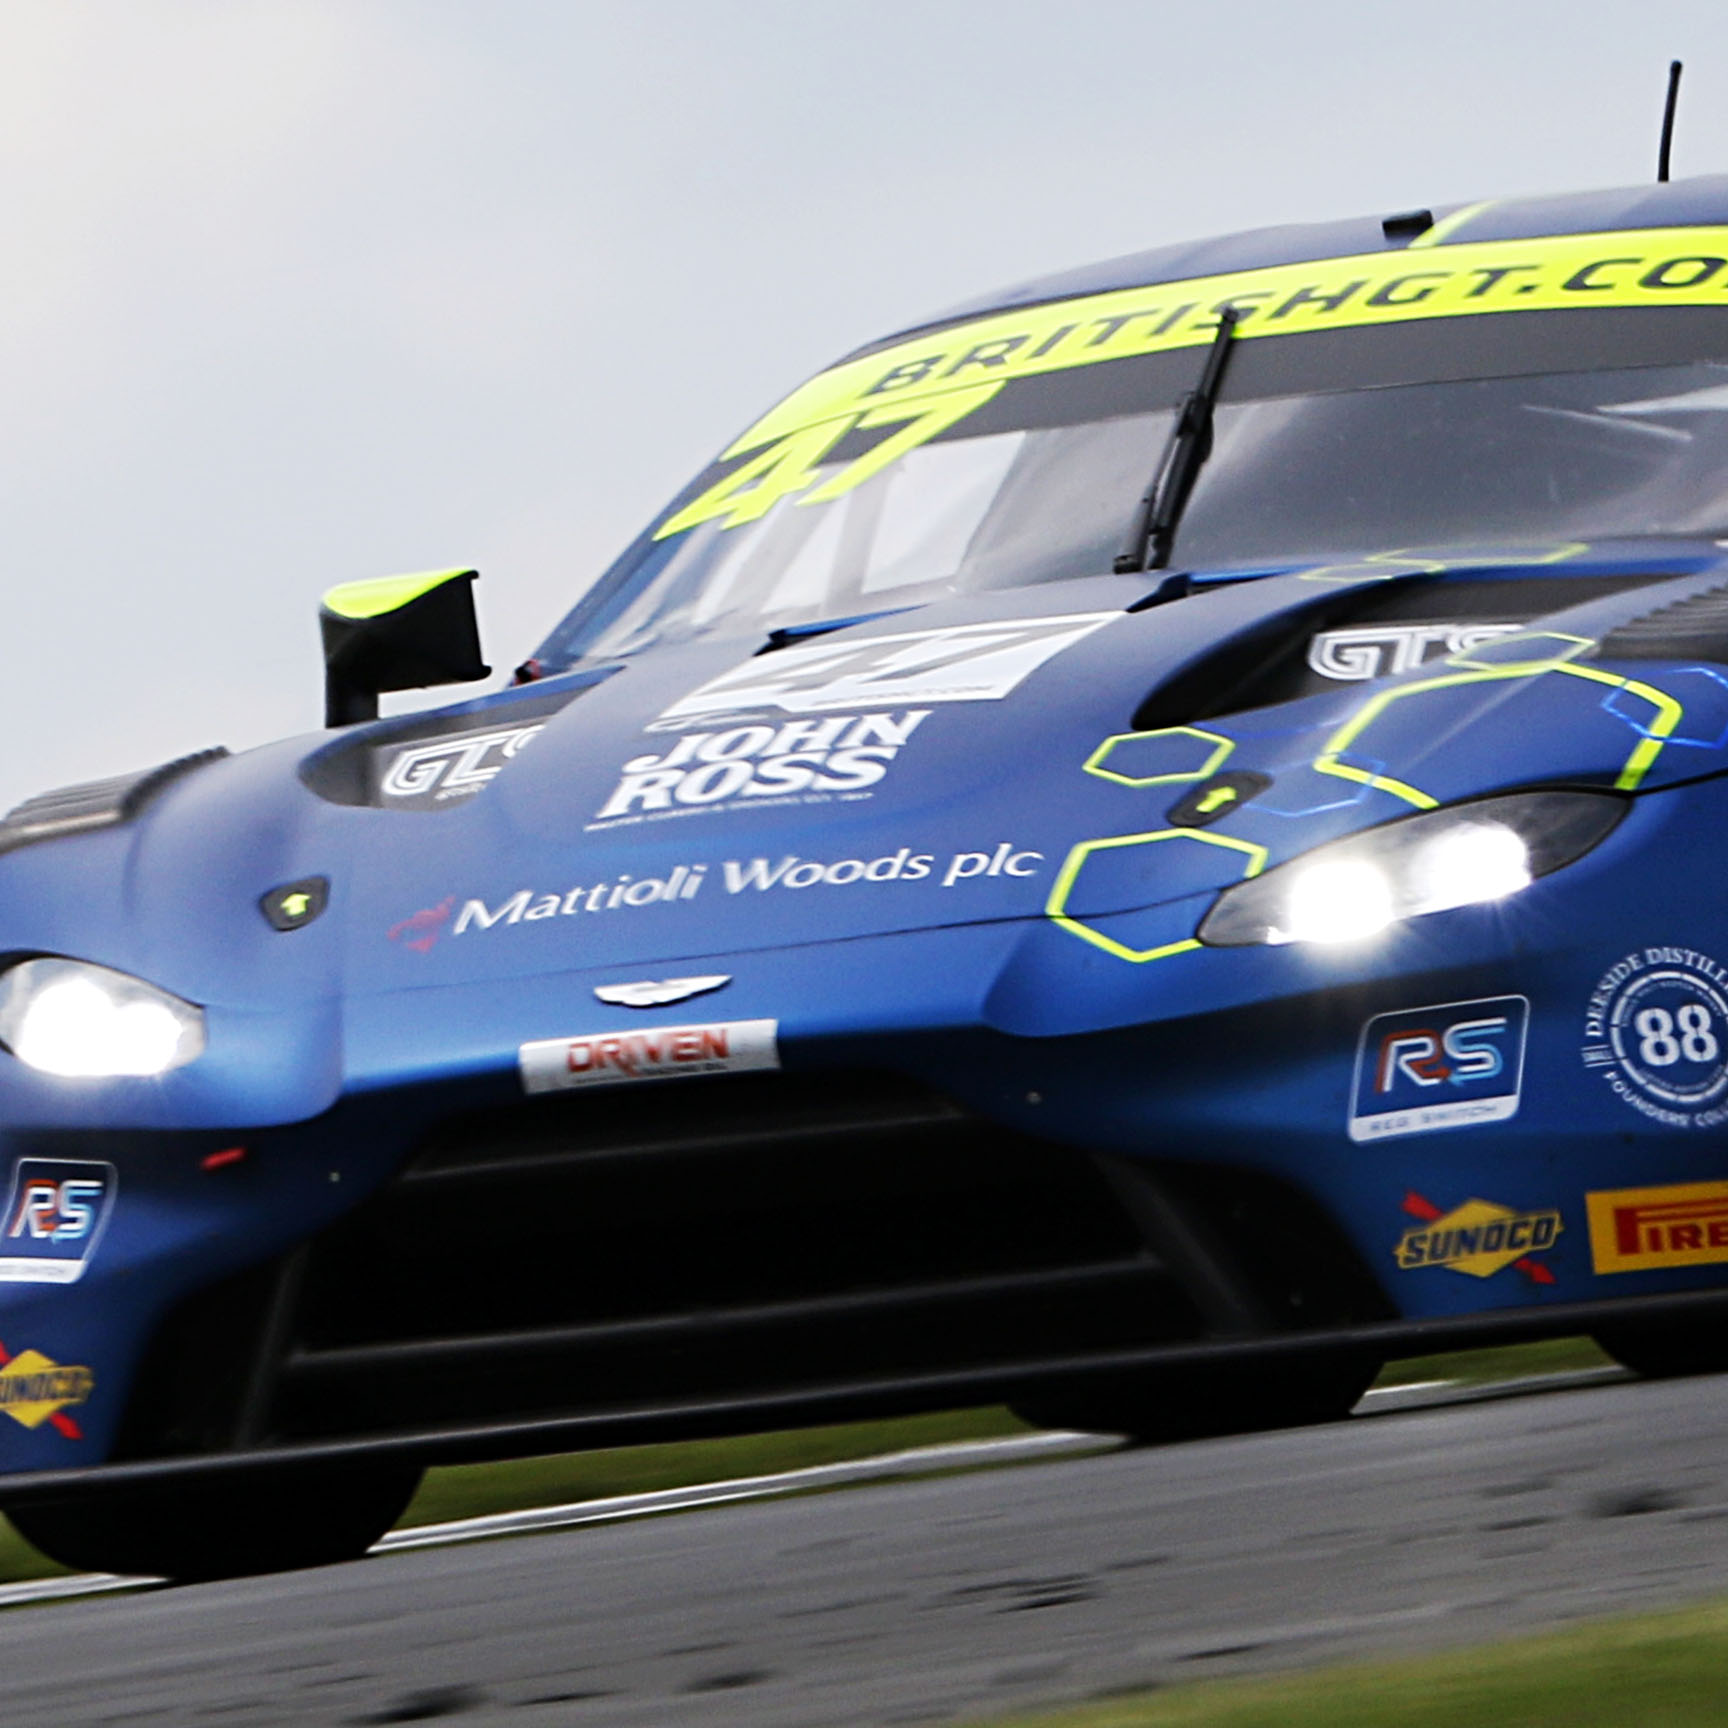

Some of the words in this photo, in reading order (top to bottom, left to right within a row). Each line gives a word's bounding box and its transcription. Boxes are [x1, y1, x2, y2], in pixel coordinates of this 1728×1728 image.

[652, 378, 1006, 542] 47
[622, 709, 934, 774] JOHN
[596, 747, 899, 819] ROSS
[452, 864, 704, 936] Mattioli
[720, 847, 934, 896] Woods
[942, 842, 1045, 887] plc
[1584, 953, 1646, 1037] DEESIDE
[567, 1028, 729, 1077] DRIVEN
[1374, 1016, 1508, 1094] RS
[1634, 1003, 1719, 1066] 88
[7, 1178, 104, 1244] RS
[1403, 1214, 1558, 1266] SUNOCO
